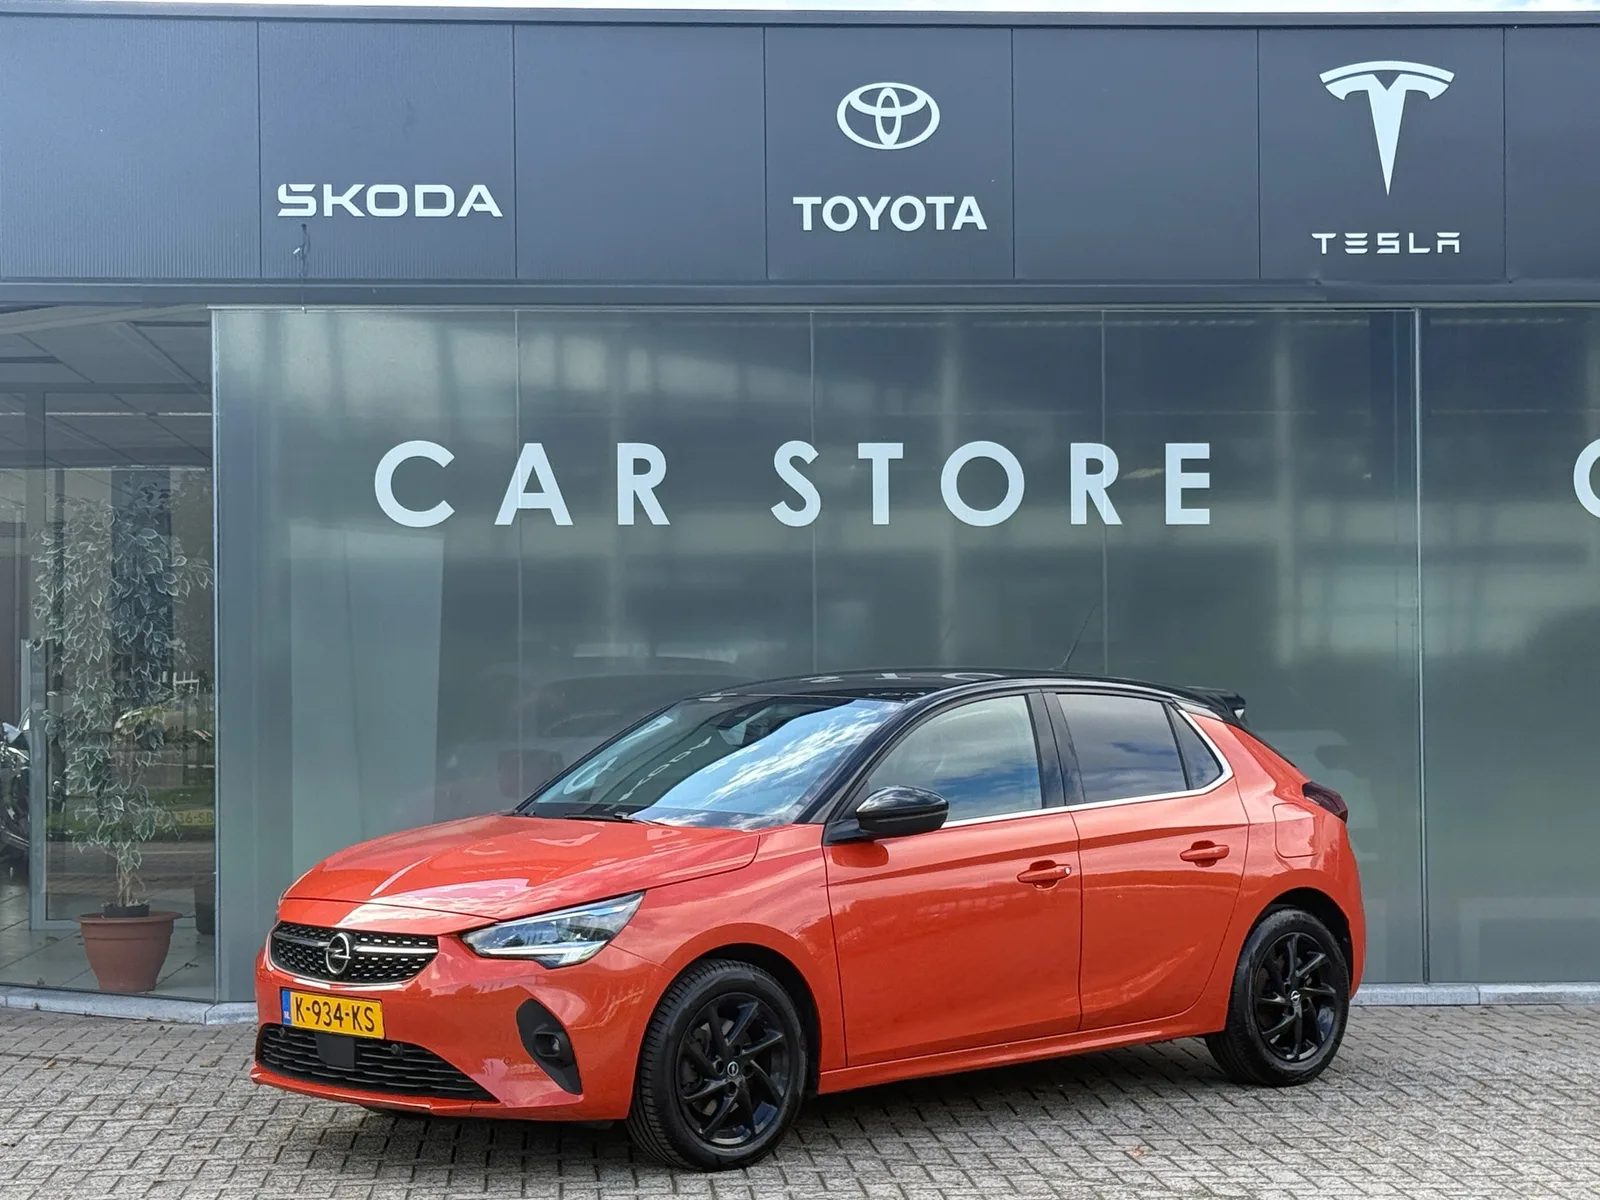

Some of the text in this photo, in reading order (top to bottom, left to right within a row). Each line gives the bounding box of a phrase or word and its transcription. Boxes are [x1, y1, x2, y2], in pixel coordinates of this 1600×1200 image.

[277, 183, 504, 217] SKODA
[792, 195, 988, 232] TOYOTA
[1311, 232, 1461, 254] TESLA
[374, 440, 1212, 528] CAR STORE
[295, 996, 375, 1033] K-934-KS
